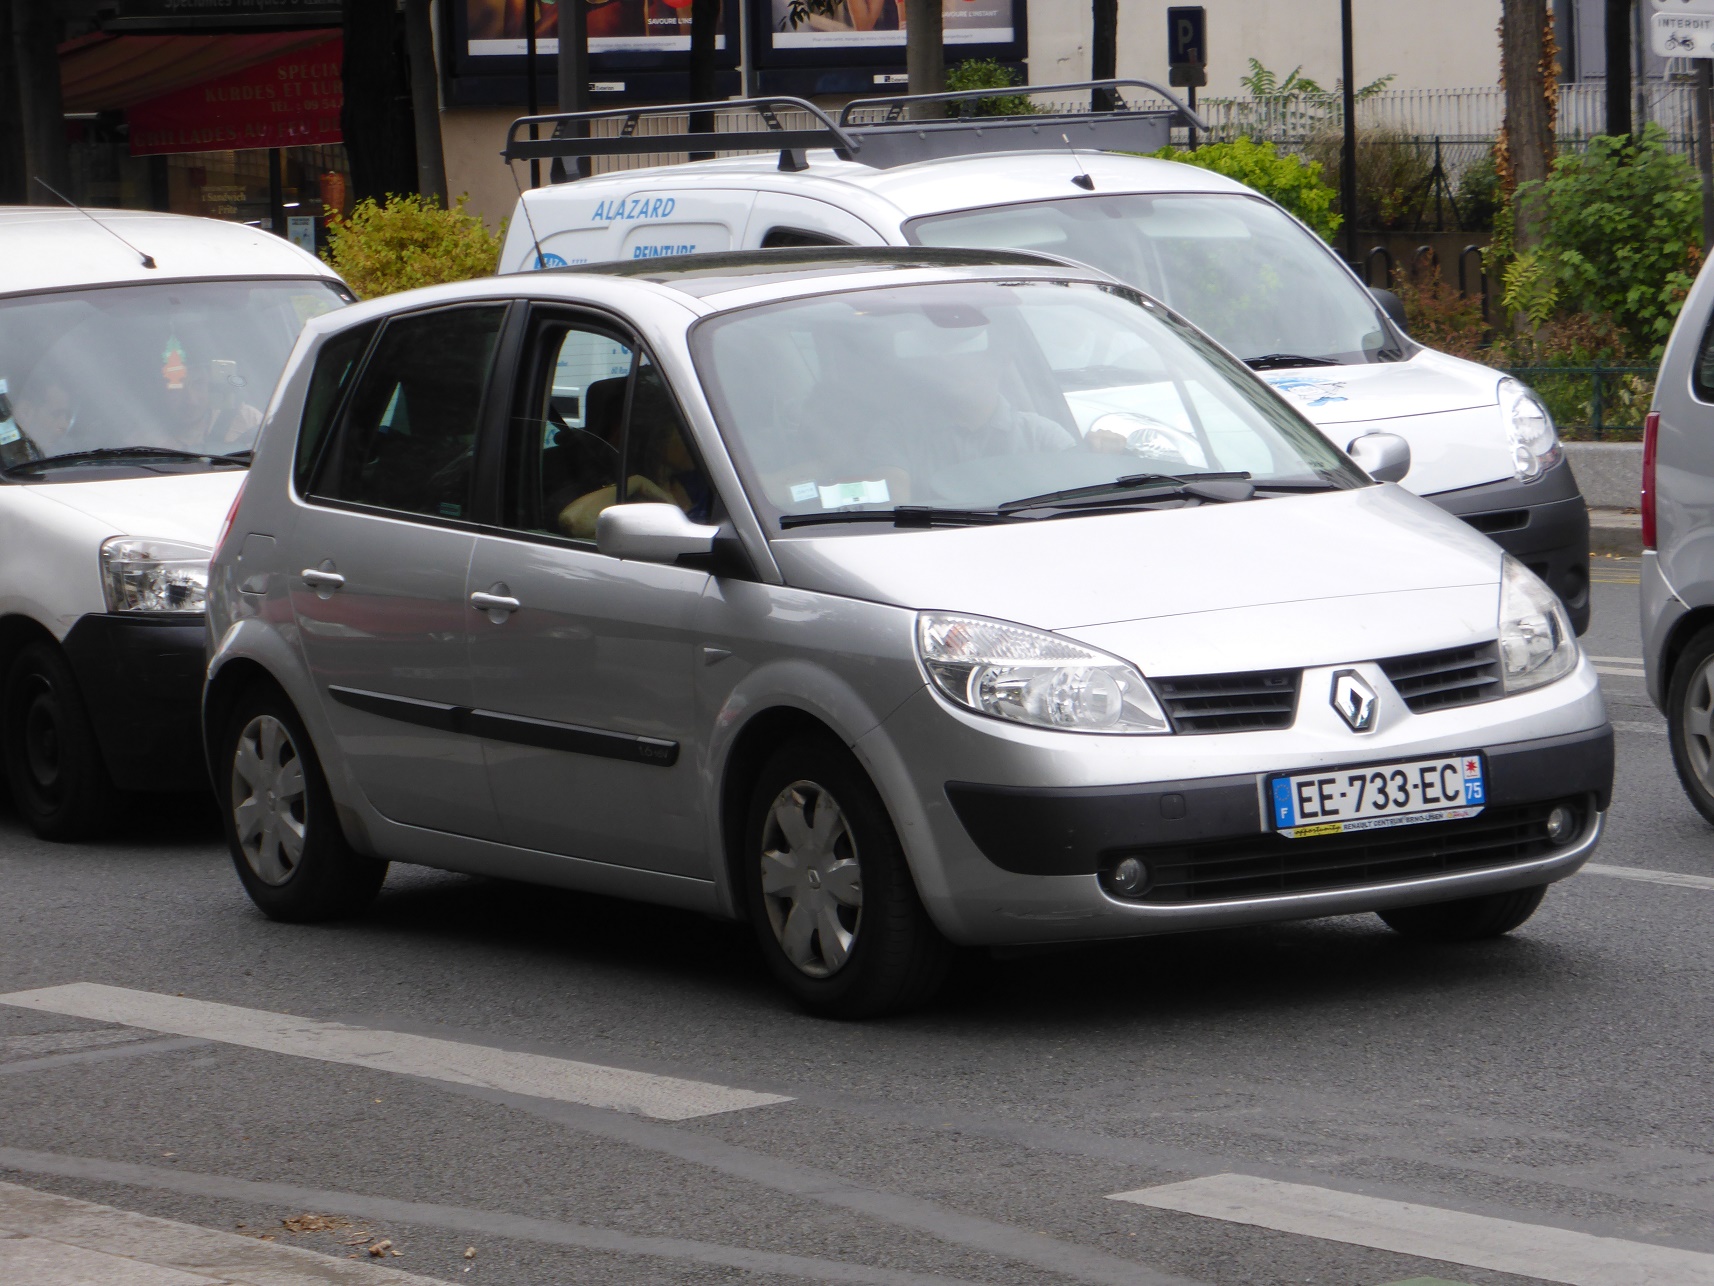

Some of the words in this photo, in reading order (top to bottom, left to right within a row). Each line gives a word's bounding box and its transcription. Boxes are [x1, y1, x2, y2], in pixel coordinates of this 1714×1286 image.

[1658, 18, 1710, 29] INTERDIT
[1177, 19, 1194, 55] P
[205, 84, 275, 103] KURDES
[283, 82, 302, 97] ET
[245, 123, 266, 138] AU
[277, 119, 310, 137] FEU
[592, 197, 676, 222] ALAZARD
[1297, 764, 1460, 819] EE-733-EC
[1465, 782, 1482, 799] 75
[1281, 807, 1290, 820] F
[1343, 820, 1372, 830] RENAULT
